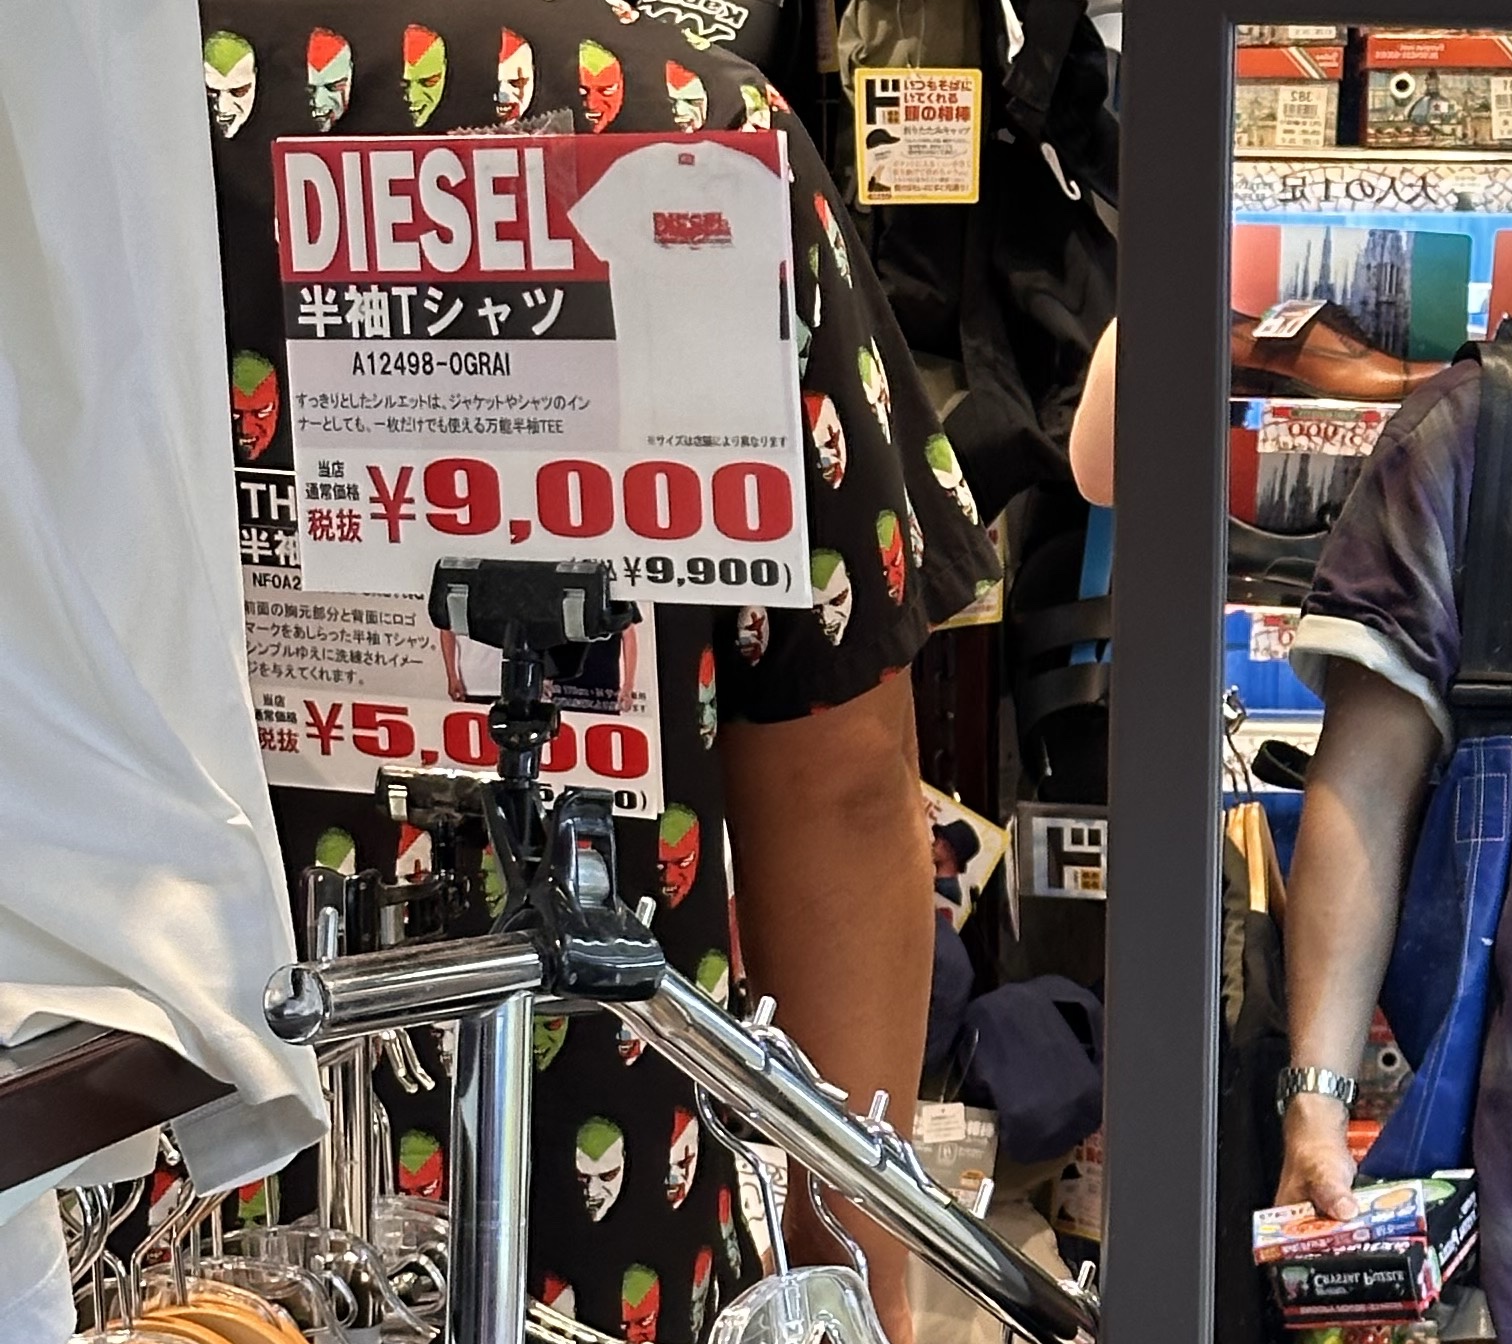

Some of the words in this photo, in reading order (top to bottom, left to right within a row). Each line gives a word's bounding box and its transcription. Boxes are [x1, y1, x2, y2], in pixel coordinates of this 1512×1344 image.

[284, 146, 575, 273] DIESEL
[298, 284, 565, 339] 半袖Tシャツ
[317, 460, 345, 479] 当店
[305, 482, 361, 502] 通常価格
[307, 508, 363, 543] 税抜
[366, 457, 795, 545] ¥9,000
[262, 693, 286, 707] 当店
